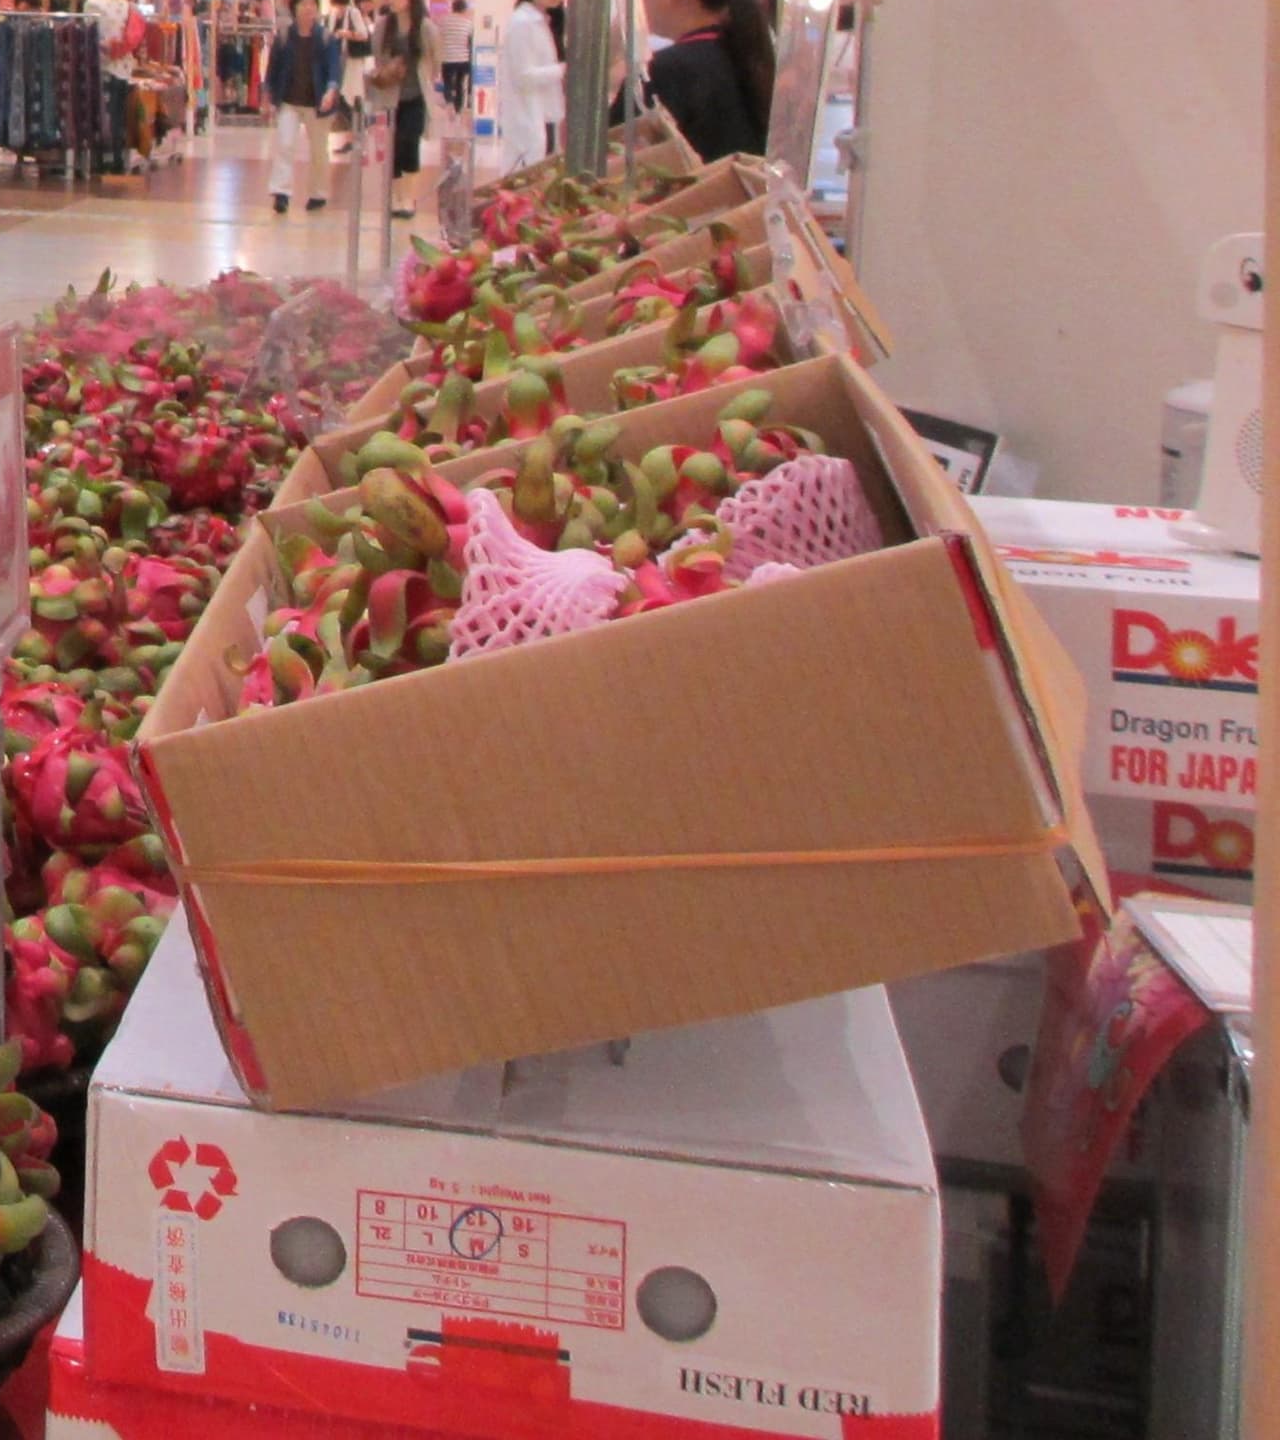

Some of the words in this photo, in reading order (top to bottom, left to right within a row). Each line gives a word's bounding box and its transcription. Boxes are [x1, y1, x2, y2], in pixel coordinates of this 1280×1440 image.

[1111, 608, 1259, 684] Dole
[1110, 709, 1210, 743] Dragon
[1220, 717, 1259, 746] Fru
[1110, 745, 1169, 787] FOR
[1177, 751, 1259, 796] JAPA
[1151, 800, 1255, 870] Do
[429, 1177, 446, 1190] kg
[524, 1190, 552, 1205] Net
[374, 1199, 386, 1215] 8
[416, 1204, 439, 1221] 10
[465, 1210, 488, 1227] 13
[512, 1215, 535, 1233] 16
[369, 1225, 392, 1241] 2L
[422, 1231, 434, 1245] L
[469, 1238, 486, 1252] M
[518, 1243, 529, 1258] S
[678, 1367, 787, 1408] FLESH
[797, 1387, 873, 1420] RED
